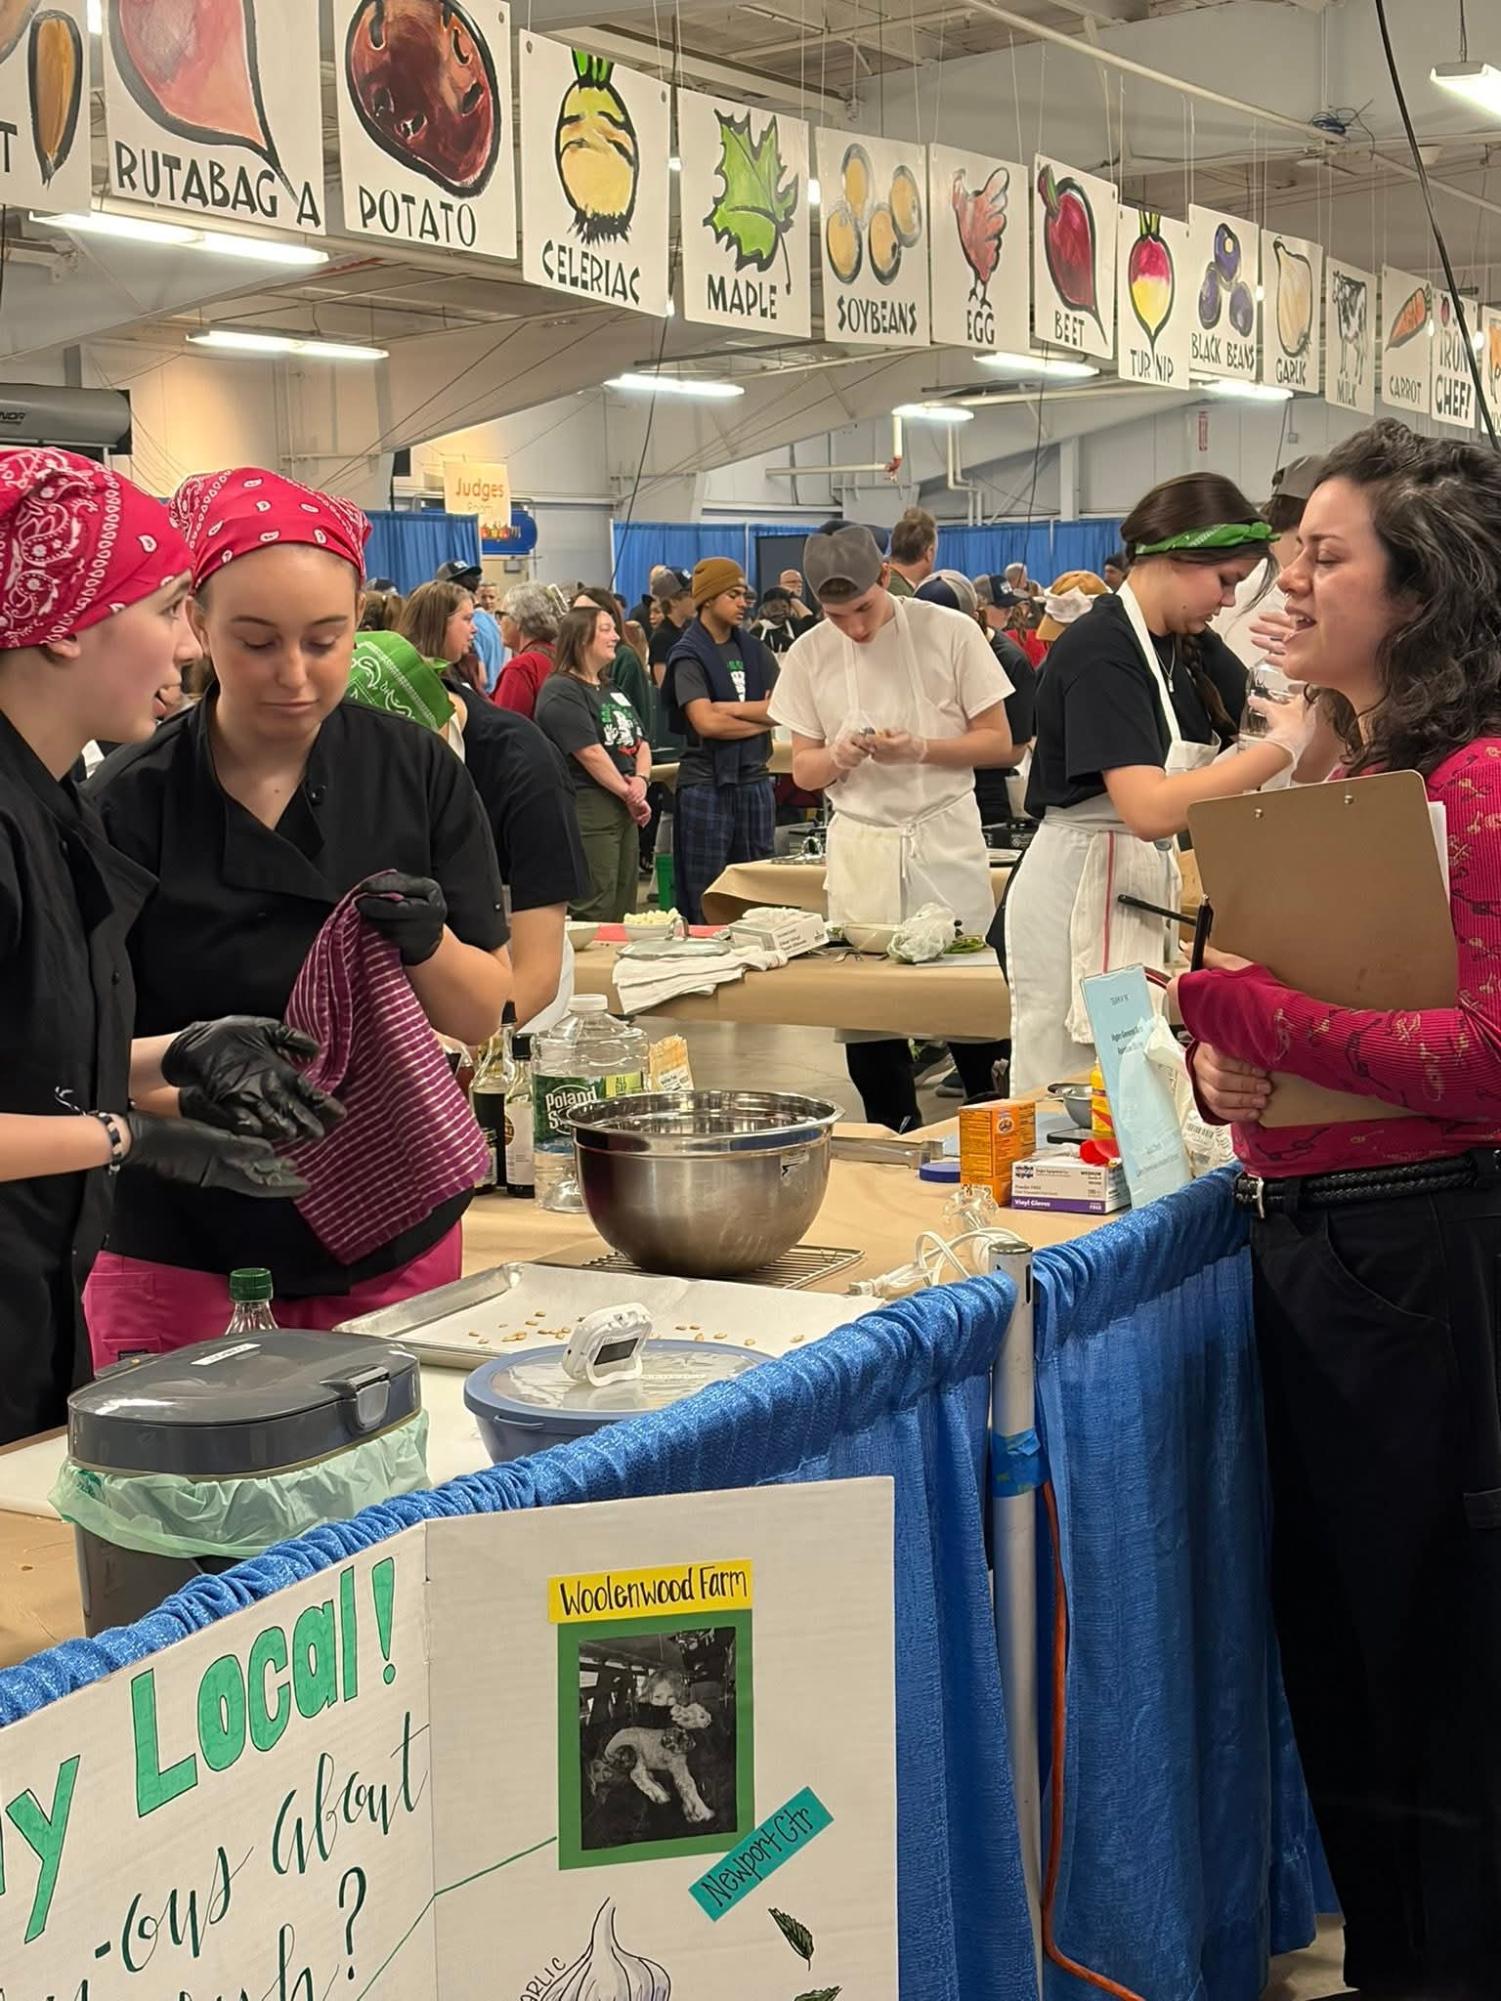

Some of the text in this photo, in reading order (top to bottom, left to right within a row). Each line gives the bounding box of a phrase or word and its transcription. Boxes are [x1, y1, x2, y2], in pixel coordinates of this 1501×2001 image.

[359, 185, 477, 247] POTATO
[542, 239, 641, 305] CELERIAC
[707, 274, 777, 320] MAPLE
[837, 295, 918, 336] SOYBEANS
[967, 309, 995, 345] EGG
[1054, 310, 1085, 347] BEET
[1191, 332, 1255, 372] BLACK BEANS
[1439, 329, 1470, 375] IRON
[1389, 375, 1422, 404] CARROT
[1435, 374, 1472, 420] CHEF!
[456, 478, 505, 501] Judges
[545, 1086, 598, 1112] Poland
[560, 1565, 748, 1617] Woolenwood Farm
[131, 1557, 395, 1818] Local!
[701, 1828, 782, 1907] Newport
